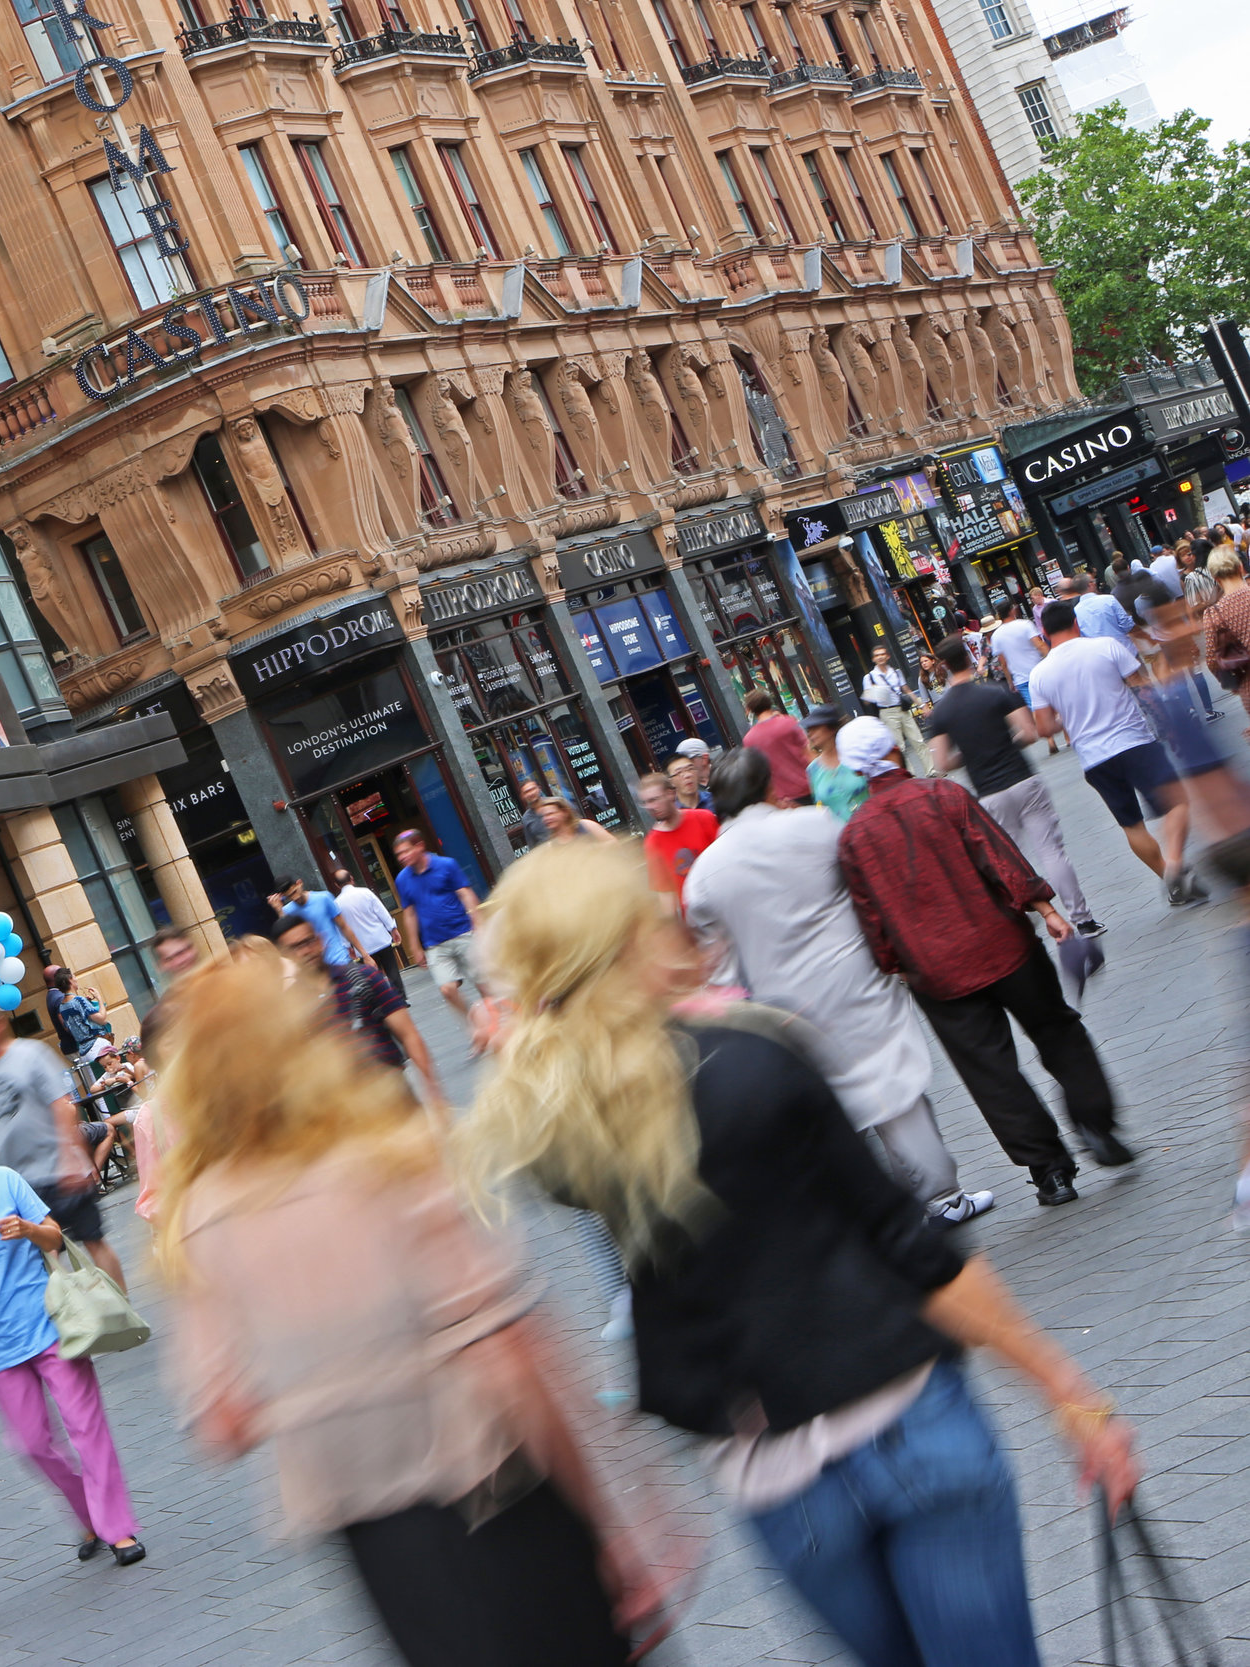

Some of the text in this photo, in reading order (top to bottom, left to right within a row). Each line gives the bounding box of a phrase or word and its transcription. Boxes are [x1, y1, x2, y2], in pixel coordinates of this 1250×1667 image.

[74, 273, 310, 400] CASINO
[1024, 424, 1133, 484] CASINO
[845, 492, 901, 525] HIPPODROME
[950, 504, 993, 532] HALF
[680, 512, 761, 553] HIPPODROME
[955, 517, 1000, 544] PRICE
[965, 530, 1003, 548] DISCOUNTED
[583, 543, 637, 578] CASINO
[429, 568, 535, 623] HIPPODROME
[608, 616, 640, 634] HIPPODROME
[622, 632, 638, 646] STORE
[251, 607, 394, 683] HIPPODROME
[529, 650, 552, 664] SMOKING
[536, 663, 558, 677] TERRACE
[287, 700, 403, 756] LONDON'S ULTIMATE
[313, 721, 388, 759] DESTINATION
[190, 781, 225, 805] BARS
